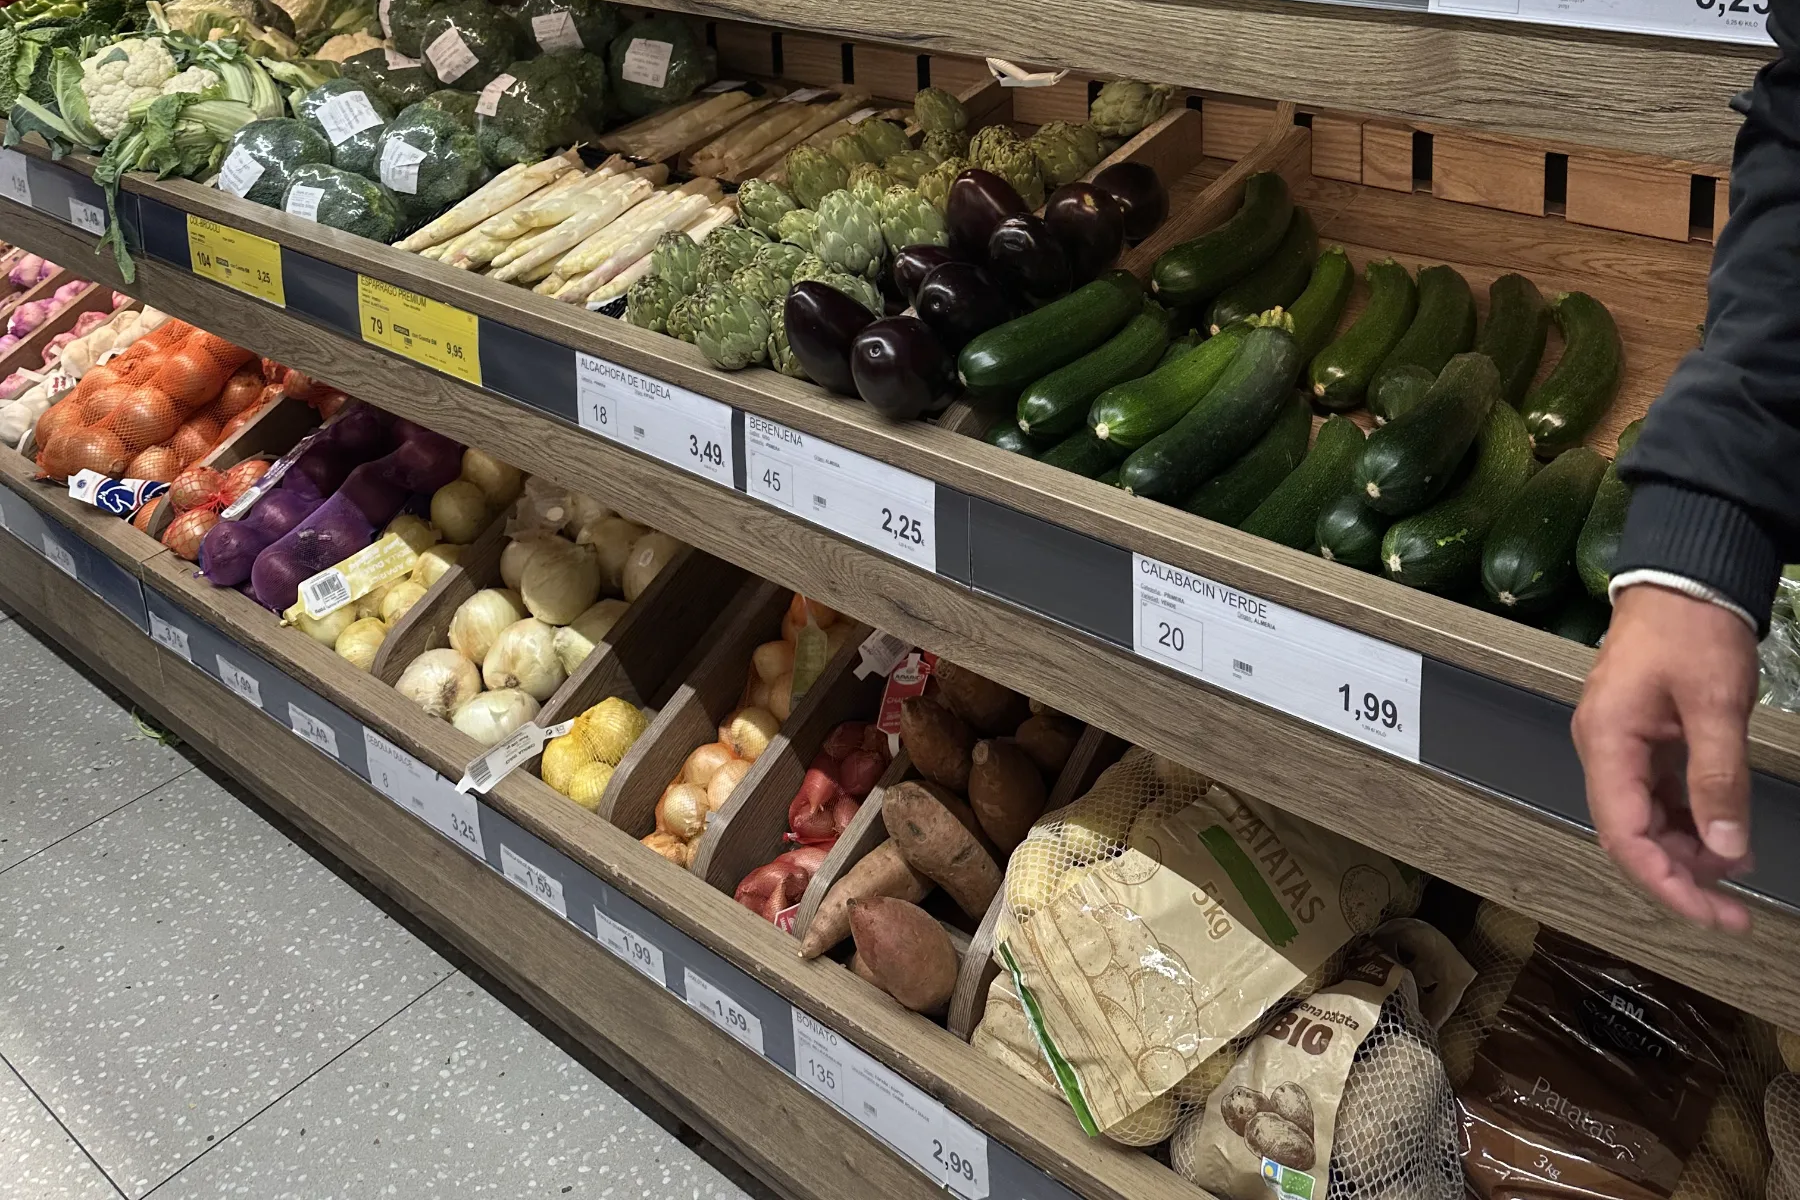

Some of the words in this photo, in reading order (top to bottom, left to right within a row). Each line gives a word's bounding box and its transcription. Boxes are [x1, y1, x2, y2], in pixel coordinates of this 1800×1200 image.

[197, 250, 211, 269] 104
[360, 275, 398, 297] ESPARRAGO
[398, 290, 427, 308] PREMIUM
[370, 316, 383, 335] 79
[580, 357, 626, 386] ALCACHOFA
[628, 374, 638, 388] DE
[640, 378, 671, 401] TUDELA
[593, 403, 607, 425] 18
[749, 416, 804, 448] BERENJENA
[763, 468, 781, 492] 45
[1140, 560, 1215, 600] CALABACIN
[1218, 588, 1267, 620] VERDE
[1158, 621, 1185, 652] 20
[366, 733, 393, 760] CEBOLLA
[393, 749, 413, 769] DULCE
[382, 772, 389, 788] 8
[1226, 804, 1325, 924] PATATAS
[1192, 881, 1232, 940] 5kg
[1322, 1008, 1360, 1031] patata
[1610, 994, 1644, 1021] BM
[796, 1012, 838, 1047] BONIATO
[1267, 1012, 1333, 1056] BIO
[808, 1058, 836, 1090] 135
[1532, 1076, 1617, 1146] Patatas
